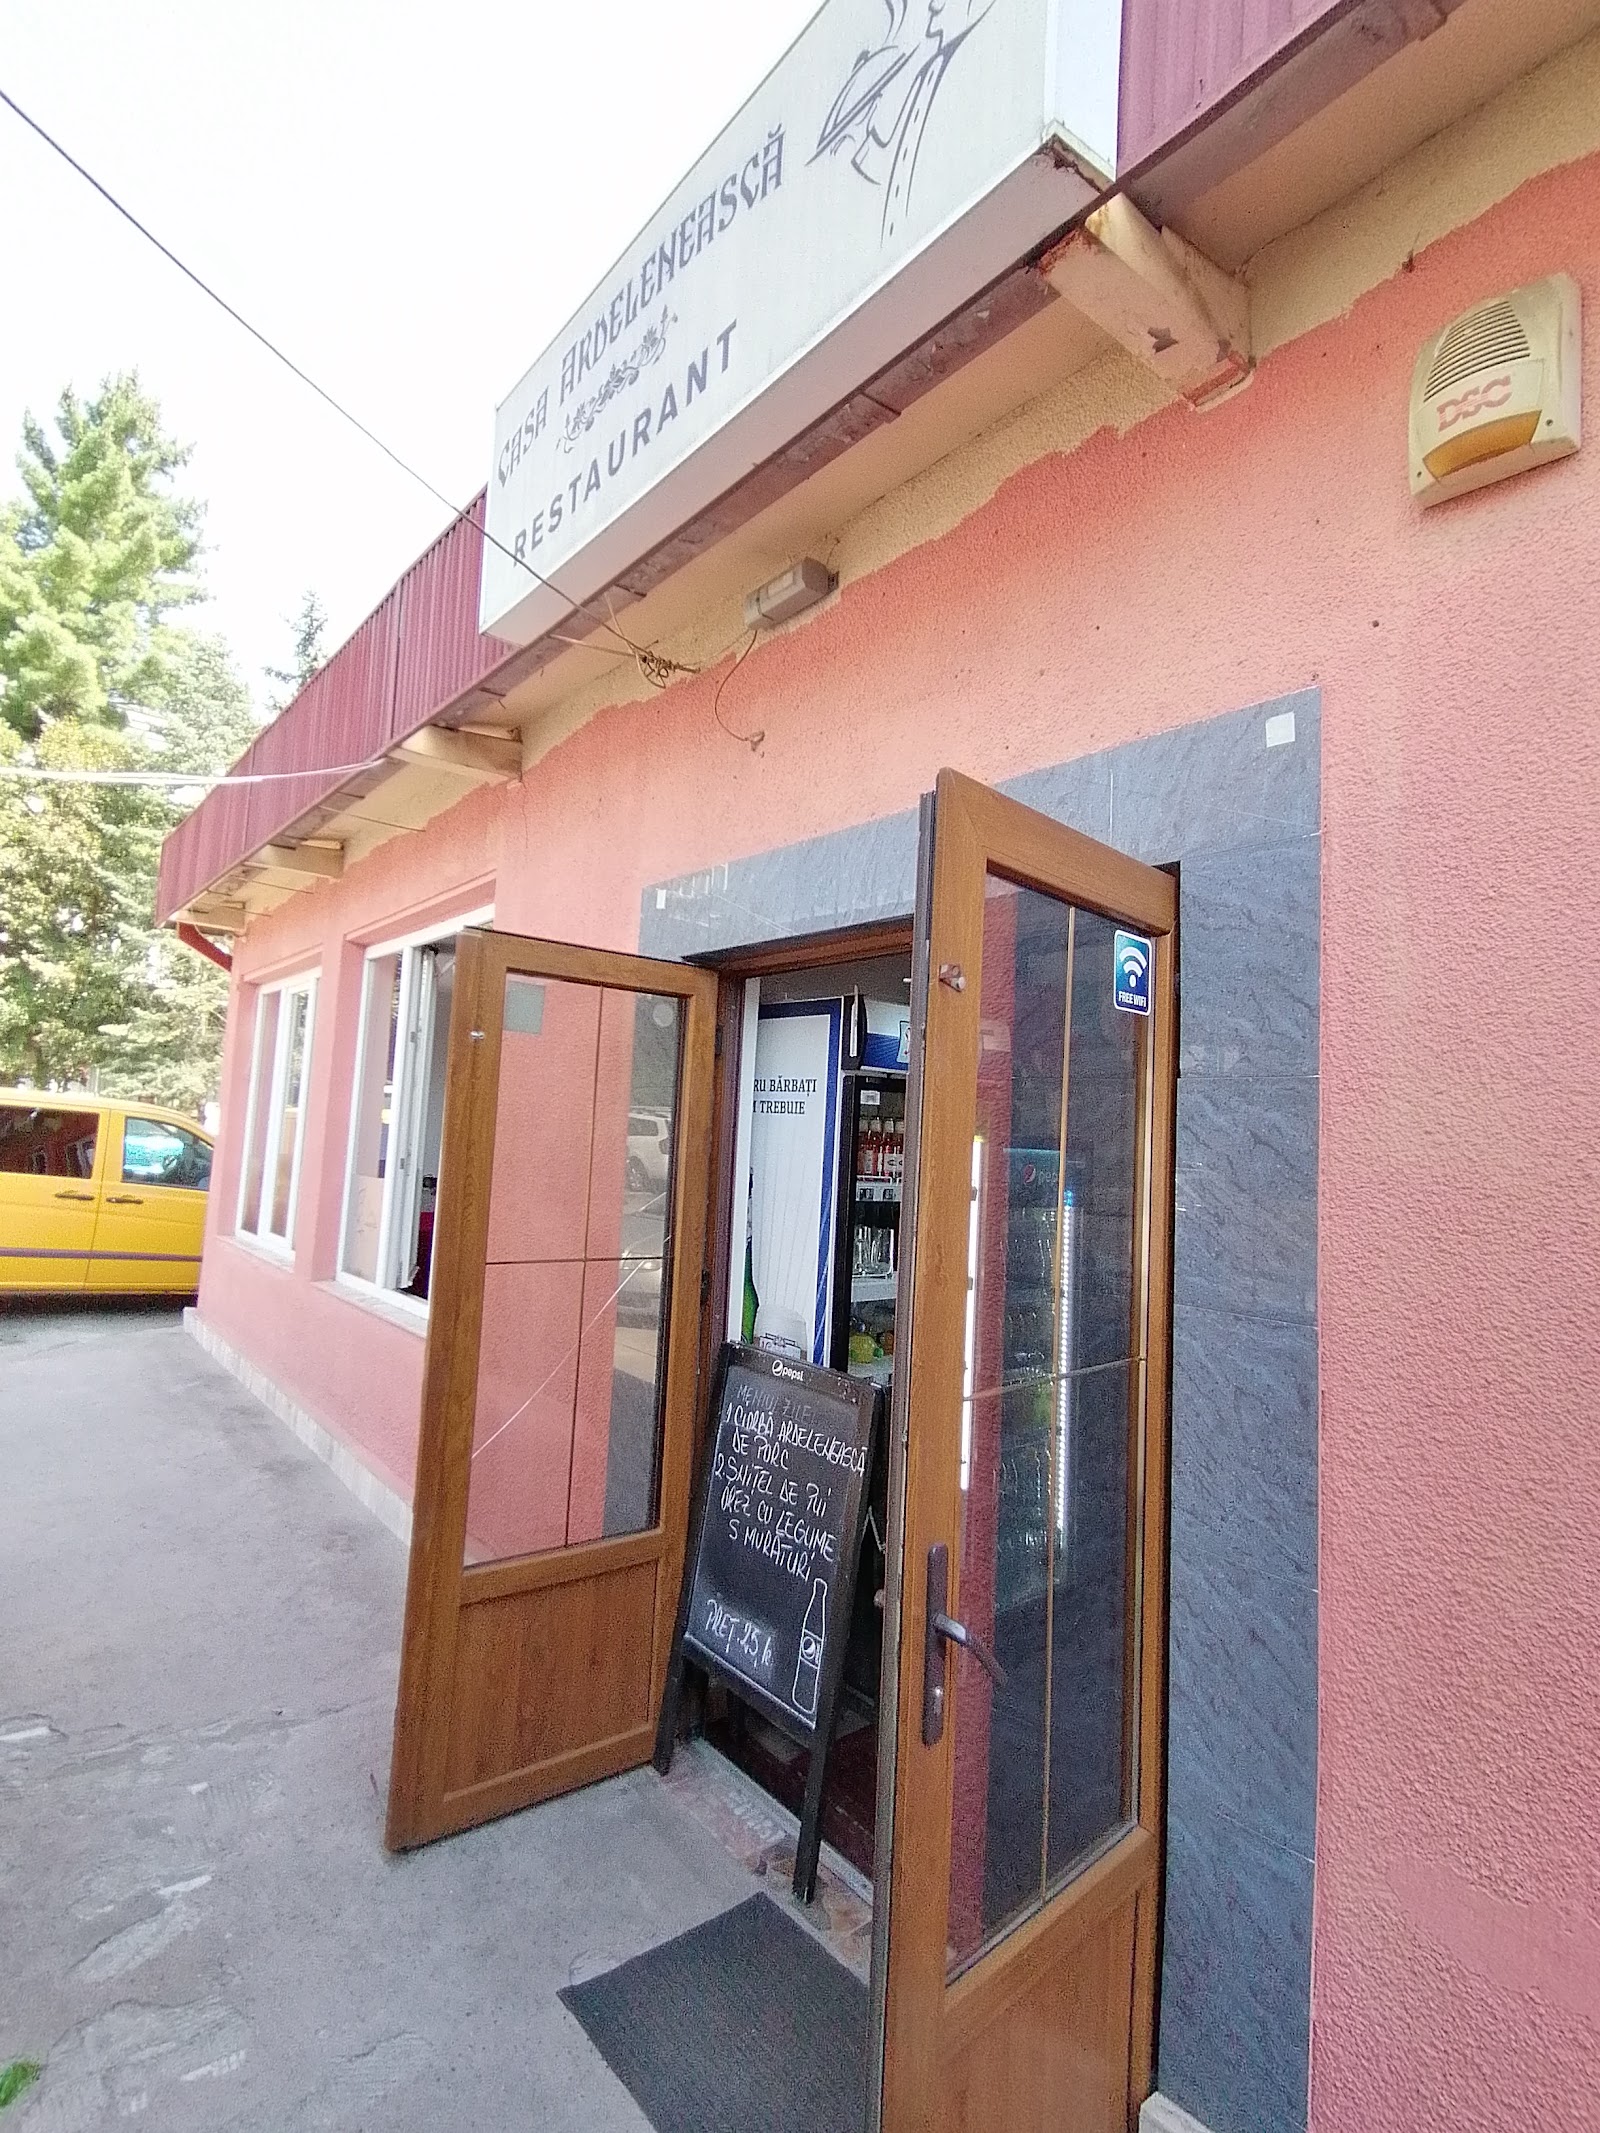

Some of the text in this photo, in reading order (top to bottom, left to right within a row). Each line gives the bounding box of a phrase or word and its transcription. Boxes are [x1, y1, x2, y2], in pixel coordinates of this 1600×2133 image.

[497, 123, 786, 488] CASA ARDELENEASCĂ
[1436, 374, 1514, 433] DSC
[513, 318, 738, 568] RESTAURANT
[1118, 990, 1147, 1007] FREE WIFI
[769, 1075, 817, 1097] BĂRBAȚI
[759, 1100, 805, 1115] TREBUIE
[781, 1367, 804, 1382] pepsi
[732, 1427, 789, 1470] DE PORC
[780, 1479, 798, 1505] DE
[721, 1484, 837, 1562] OREZ CU LEGUME
